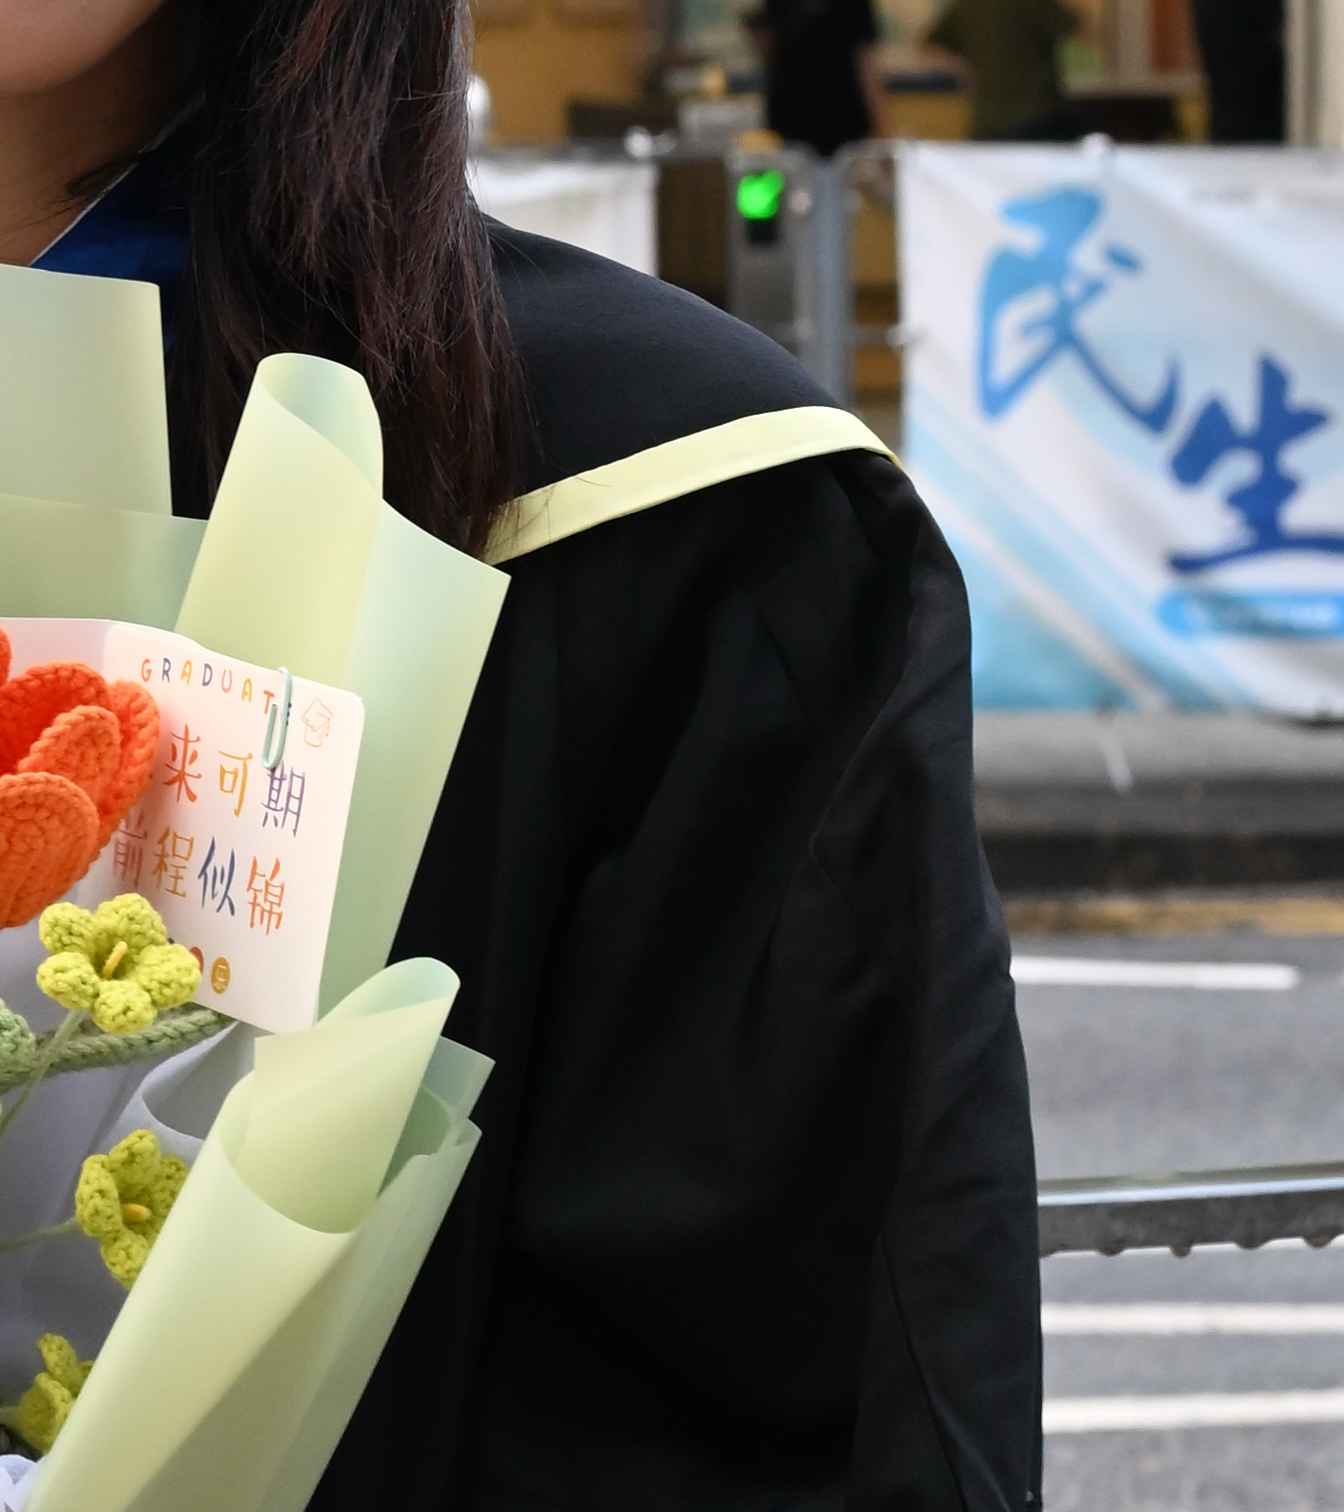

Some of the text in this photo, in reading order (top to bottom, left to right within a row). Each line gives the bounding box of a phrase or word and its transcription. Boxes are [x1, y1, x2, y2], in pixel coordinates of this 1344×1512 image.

[141, 657, 291, 722] GRADUAT
[164, 723, 305, 836] 来可期
[115, 810, 286, 935] 前程似锦
